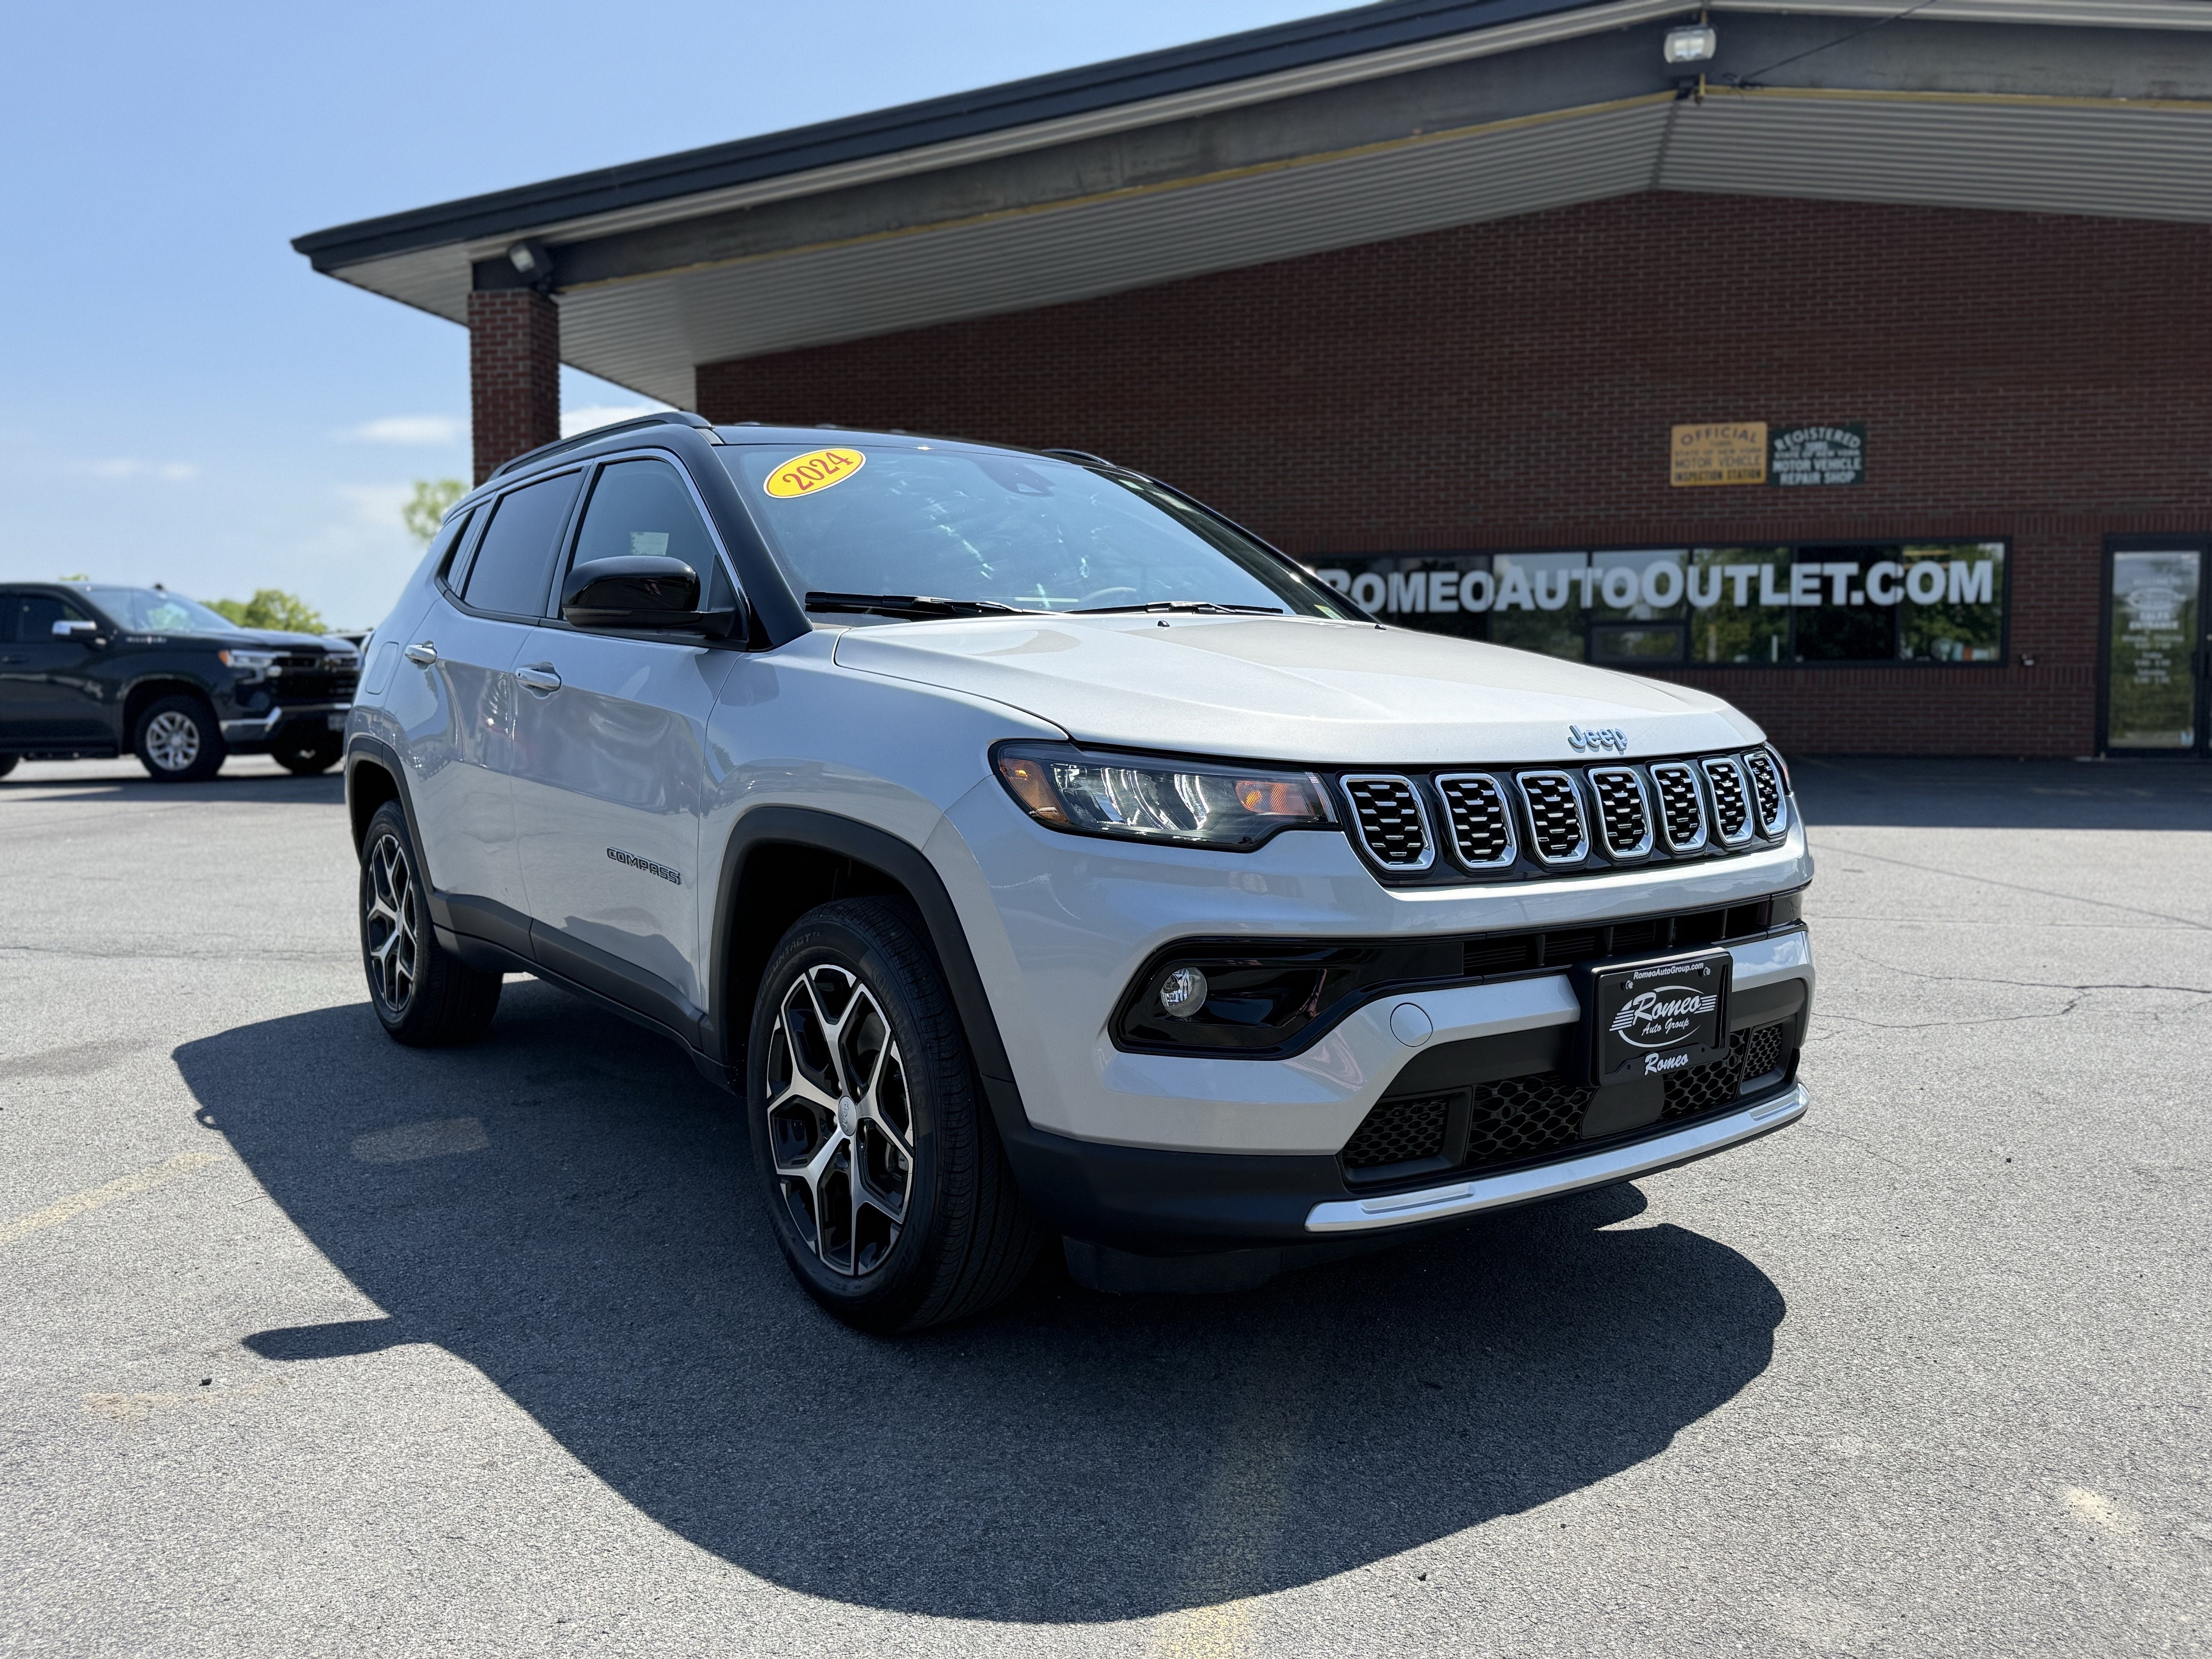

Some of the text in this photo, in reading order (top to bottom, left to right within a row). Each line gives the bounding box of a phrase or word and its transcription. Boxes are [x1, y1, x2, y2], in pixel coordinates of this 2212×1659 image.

[1681, 427, 1757, 445] OFFICIAL
[1774, 427, 1861, 451] REGISTERED
[1675, 455, 1760, 468] MOTOR VEHICLE
[1772, 457, 1862, 472] MOTOR VEHICLE
[782, 452, 854, 491] 2024
[1675, 469, 1761, 482] INSPECTION STATION
[1780, 471, 1856, 486] REPAIR SHOP
[1568, 725, 1628, 751] Jeep
[606, 847, 682, 885] COMPASS
[1633, 962, 1704, 980] RomeoAutoGroup.com
[1632, 992, 1702, 1025] Romeo
[1641, 1017, 1690, 1036] Auto Group
[1644, 1053, 1689, 1076] Romeo
